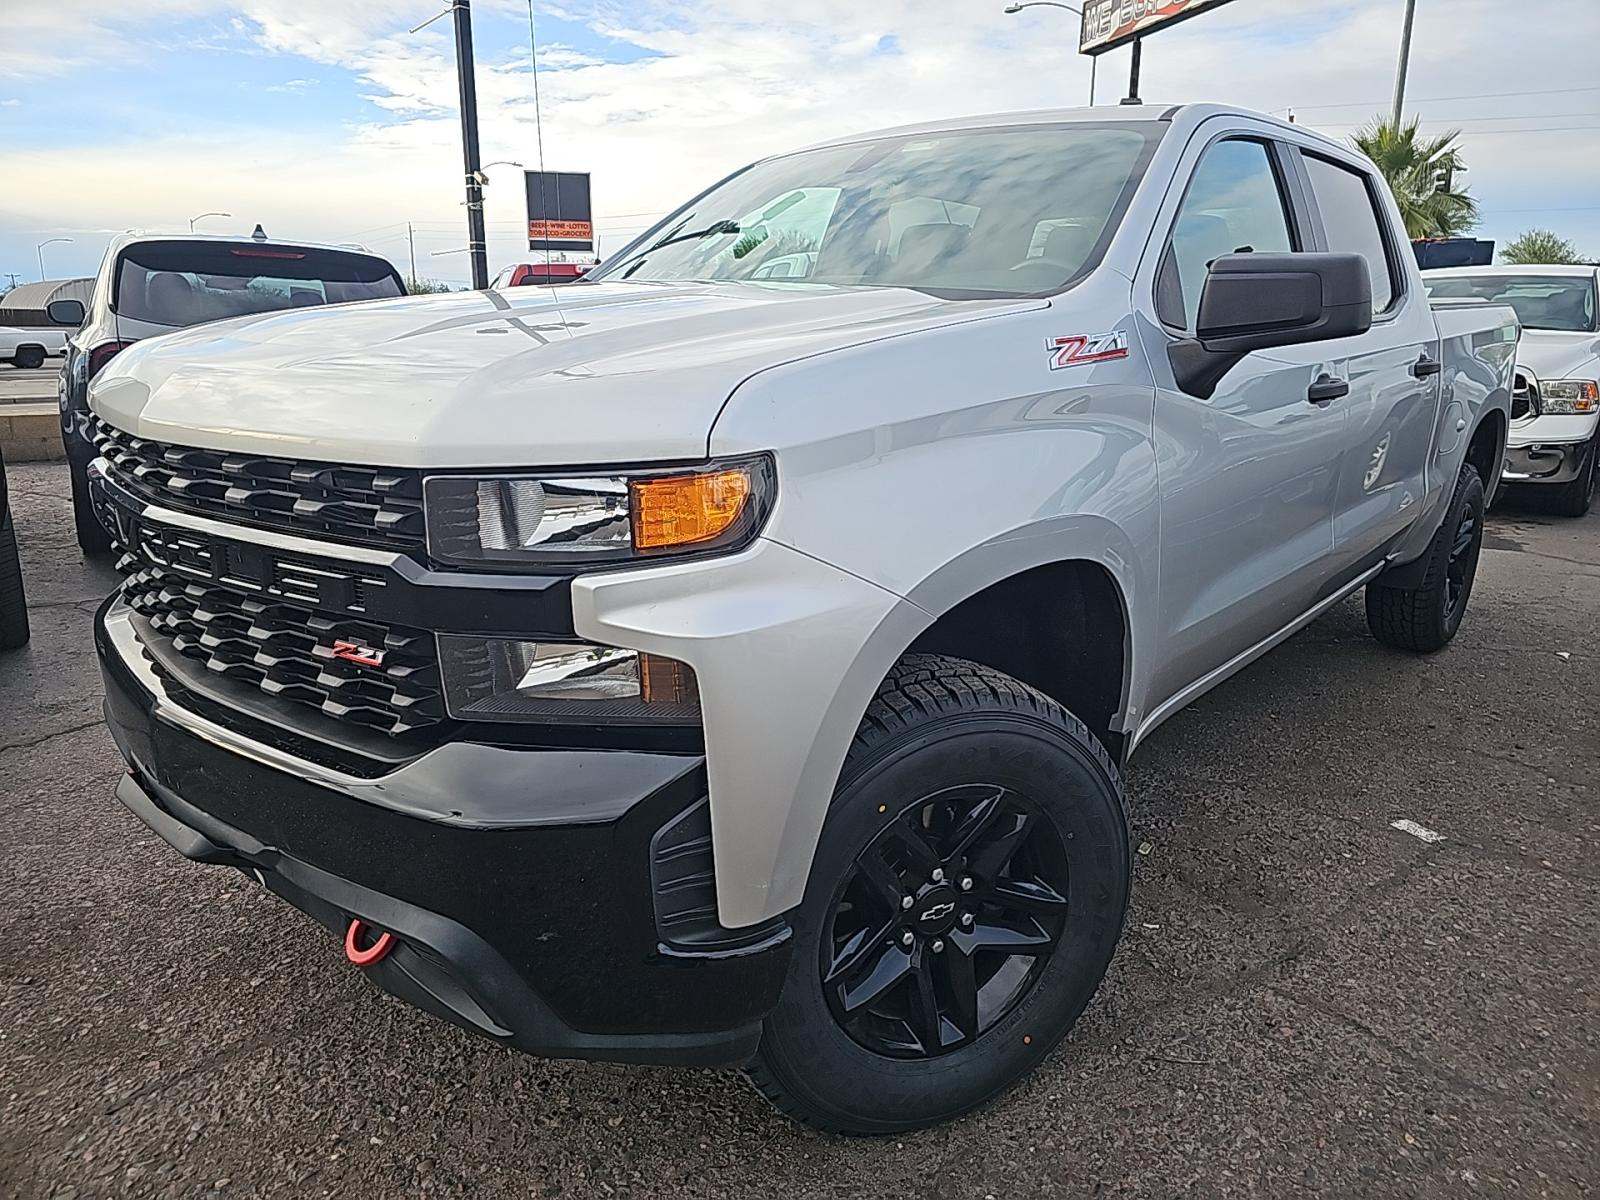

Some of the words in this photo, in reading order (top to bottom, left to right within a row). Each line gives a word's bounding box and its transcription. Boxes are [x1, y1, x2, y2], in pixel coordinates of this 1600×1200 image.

[1085, 1, 1112, 41] WE
[1046, 330, 1129, 371] Z71
[333, 640, 384, 667] Z71
